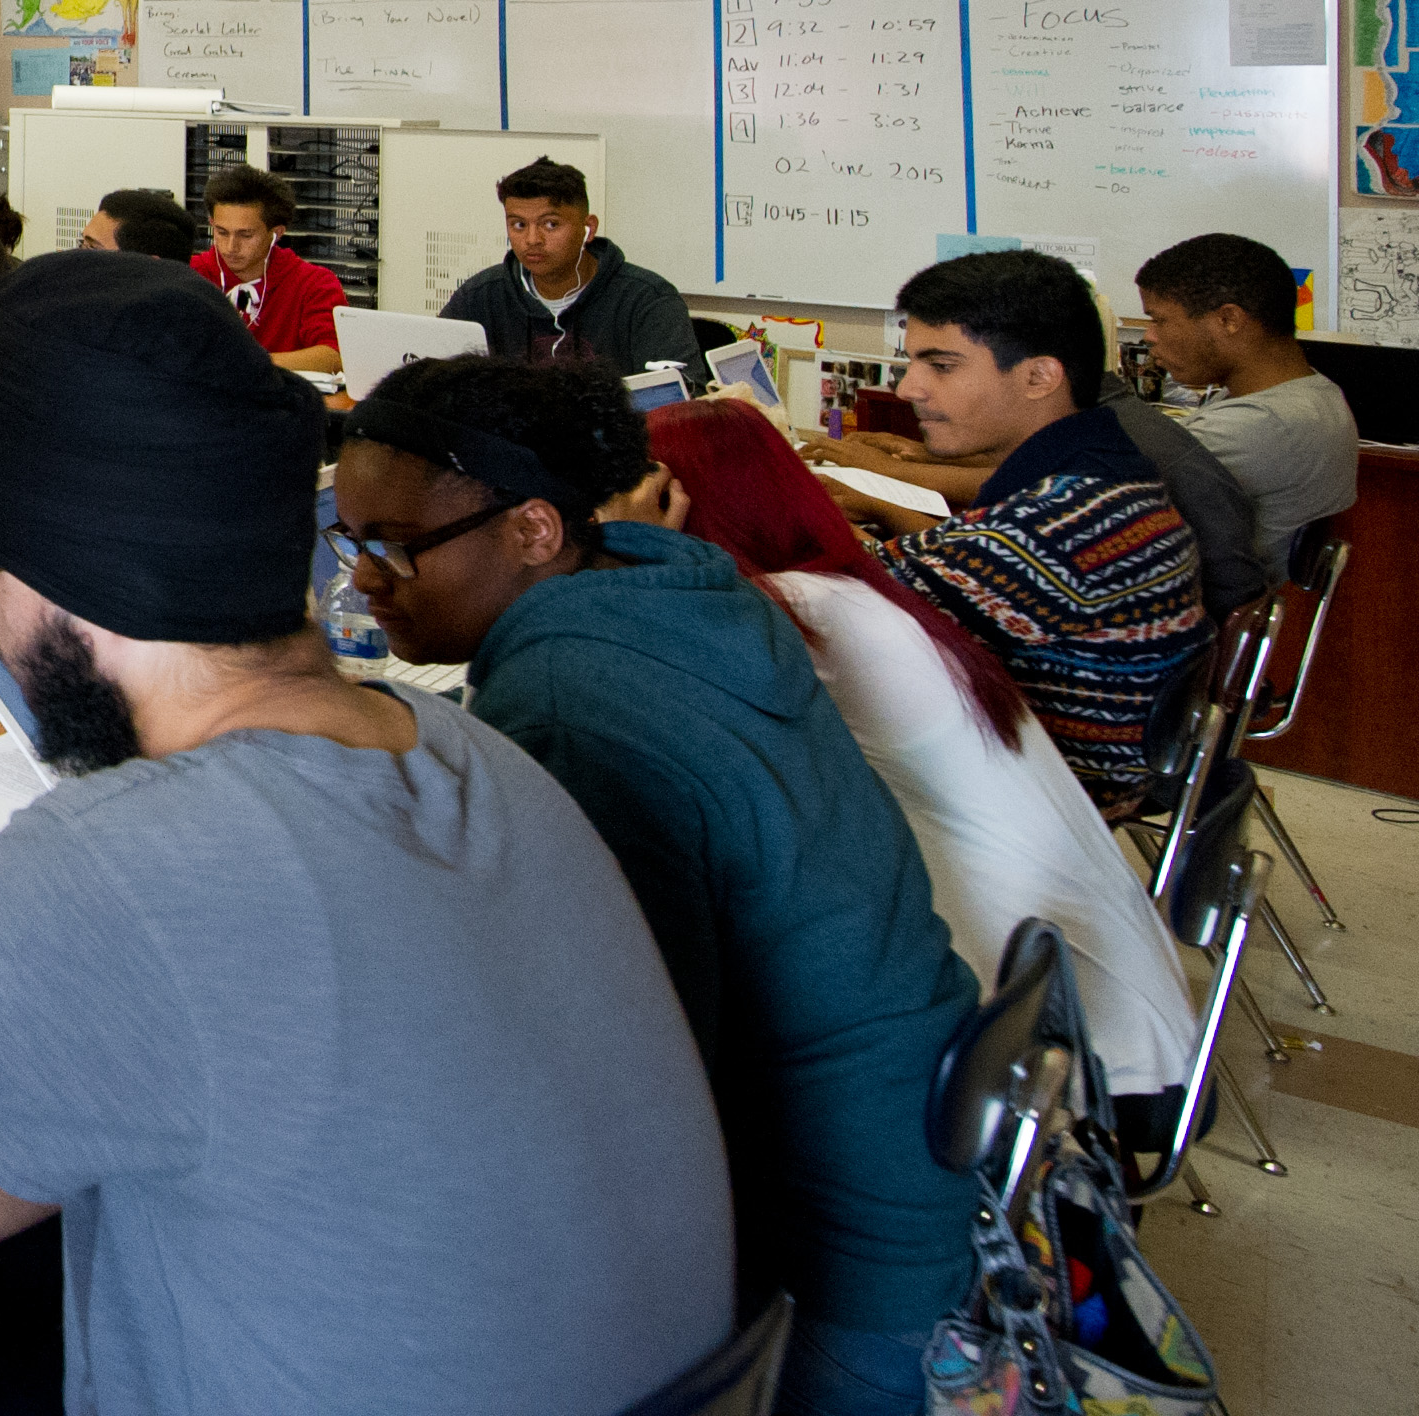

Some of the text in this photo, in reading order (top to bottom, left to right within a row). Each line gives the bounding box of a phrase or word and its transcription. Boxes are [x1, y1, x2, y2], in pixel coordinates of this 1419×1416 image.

[767, 19, 824, 38] 9:32
[870, 18, 937, 32] 10:59
[728, 51, 926, 73] Adv 11:04 11:29
[774, 82, 825, 100] 12:04
[877, 83, 921, 97] 1:31
[1015, 104, 1093, 119] Achieve
[1122, 102, 1185, 114] balance
[779, 111, 821, 130] 1:36
[869, 112, 922, 132] 3:03
[775, 156, 811, 174] 02
[889, 161, 944, 184] 2015
